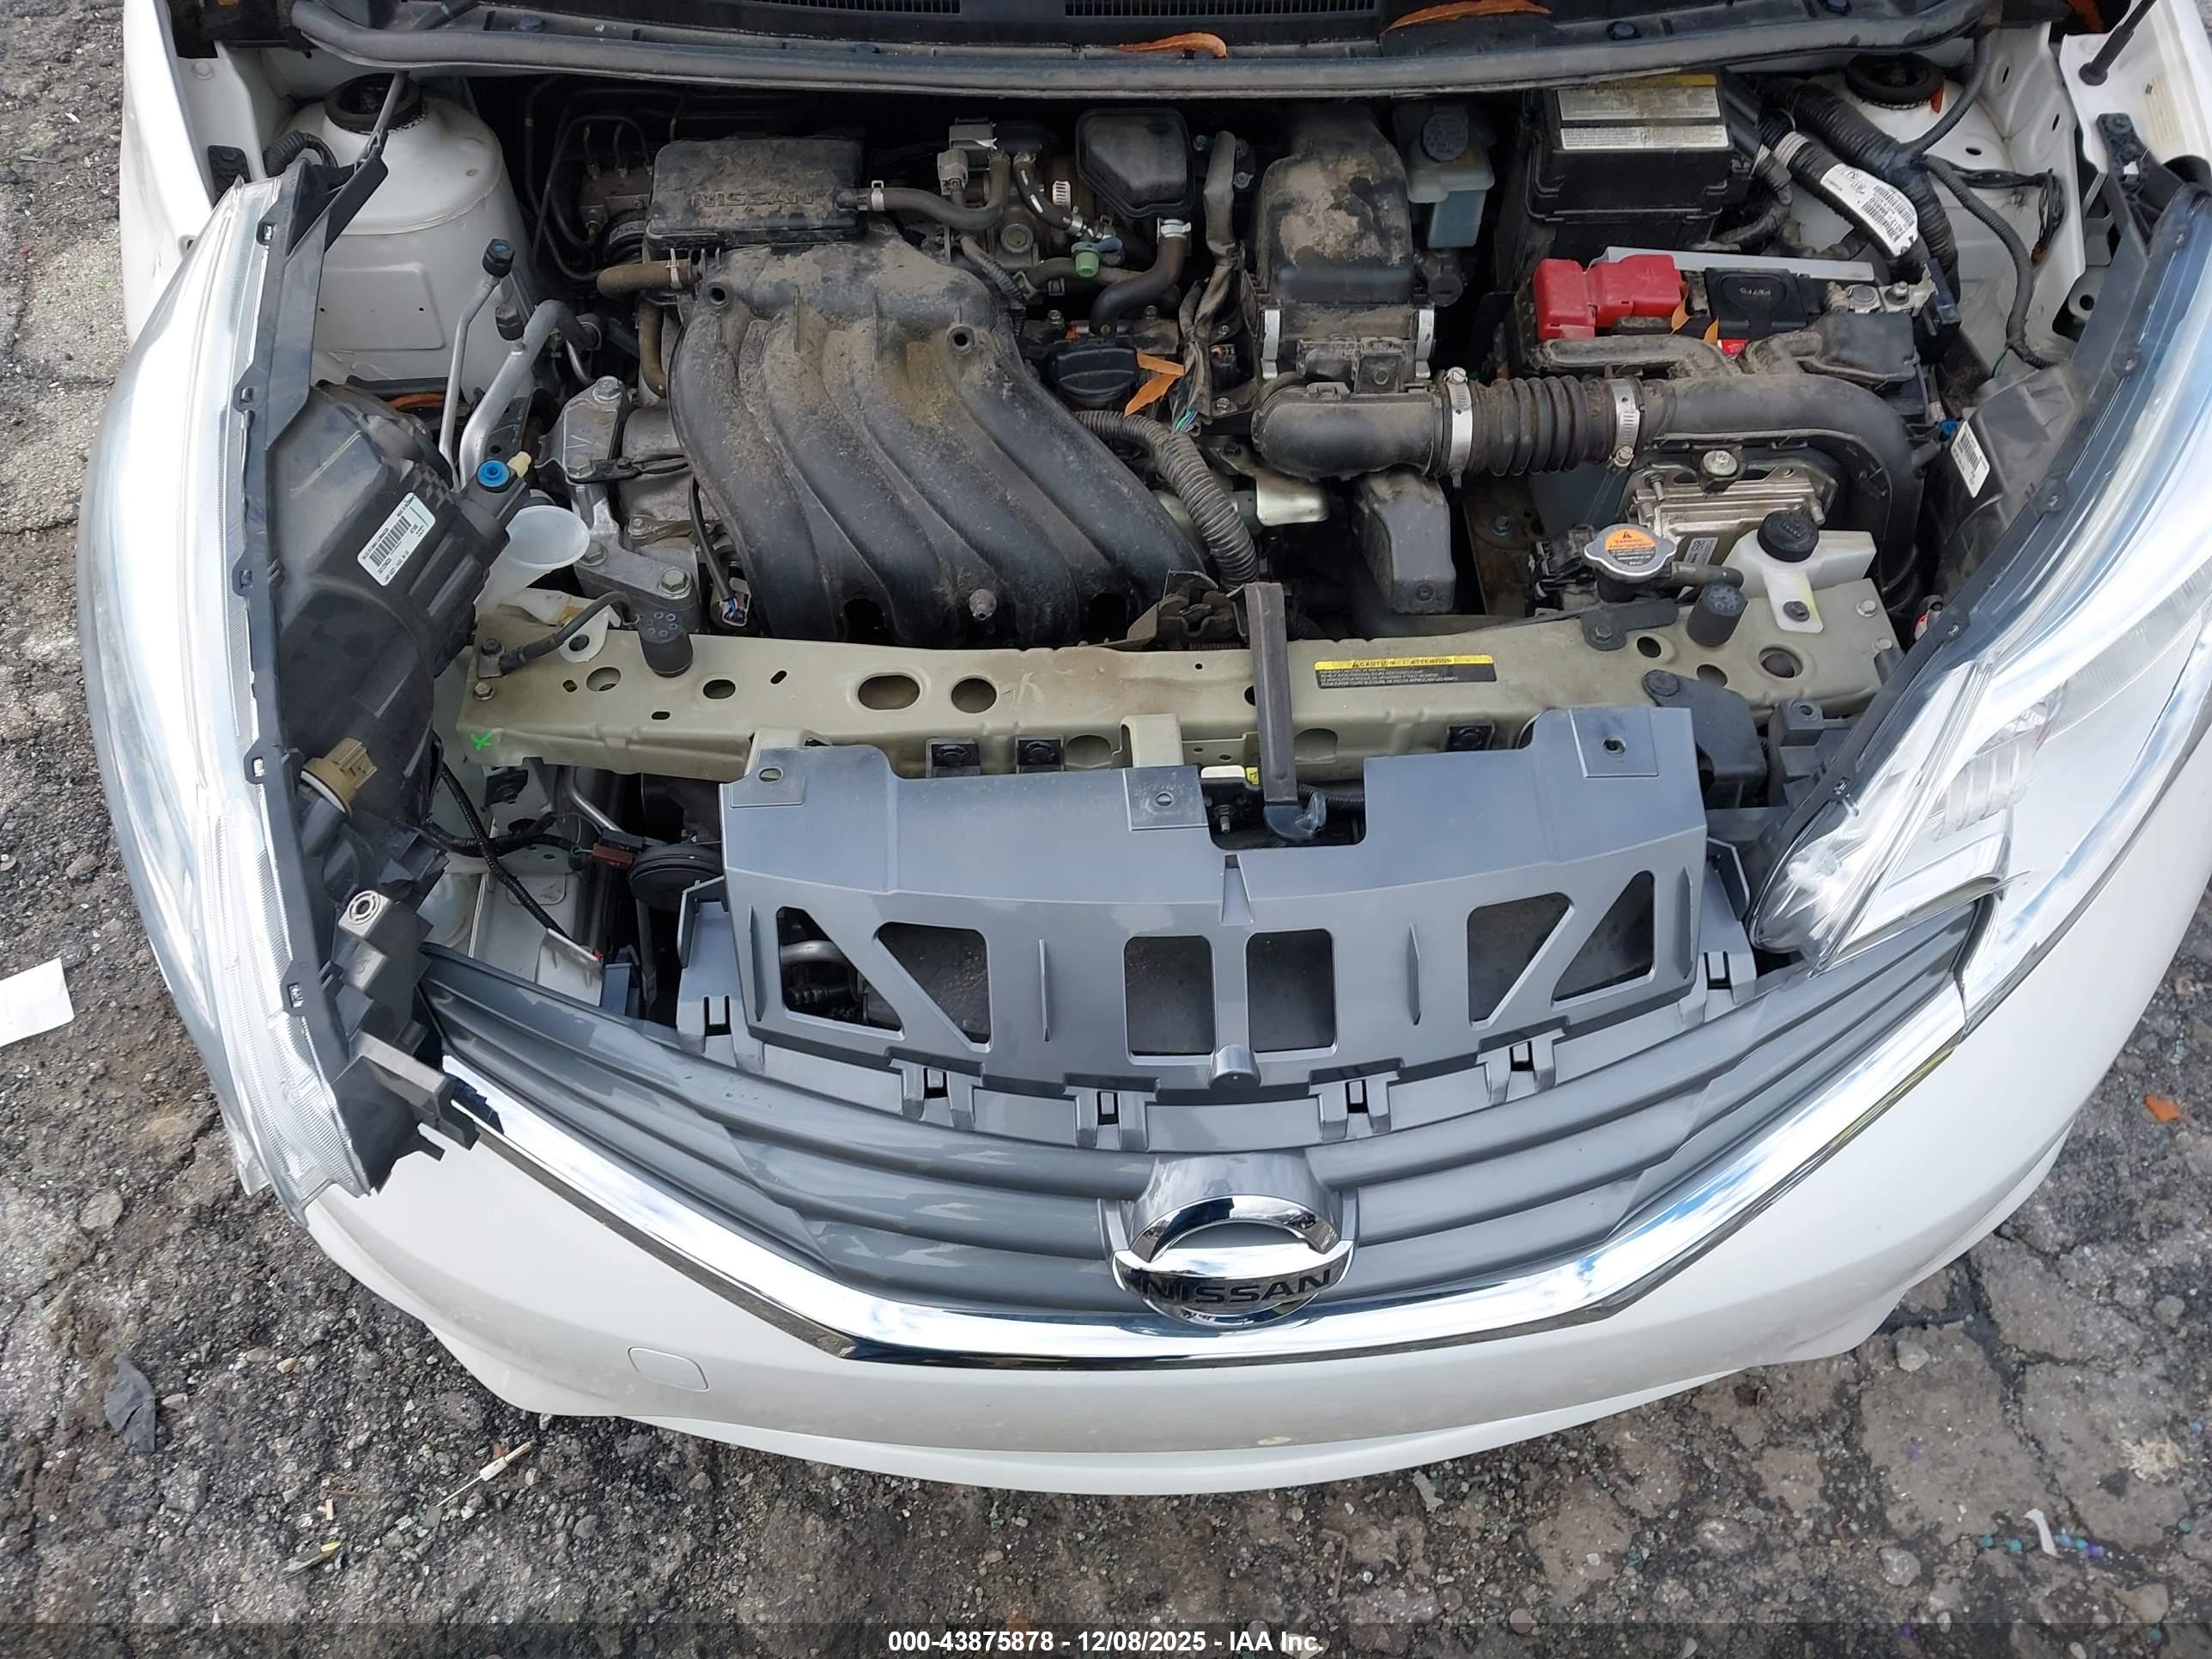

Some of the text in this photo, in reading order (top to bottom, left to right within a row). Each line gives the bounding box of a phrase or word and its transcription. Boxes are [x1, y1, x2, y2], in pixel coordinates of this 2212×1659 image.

[692, 191, 817, 208] NISSAN
[1358, 659, 1395, 668] CAUTION
[1139, 1268, 1331, 1304] NISSAN
